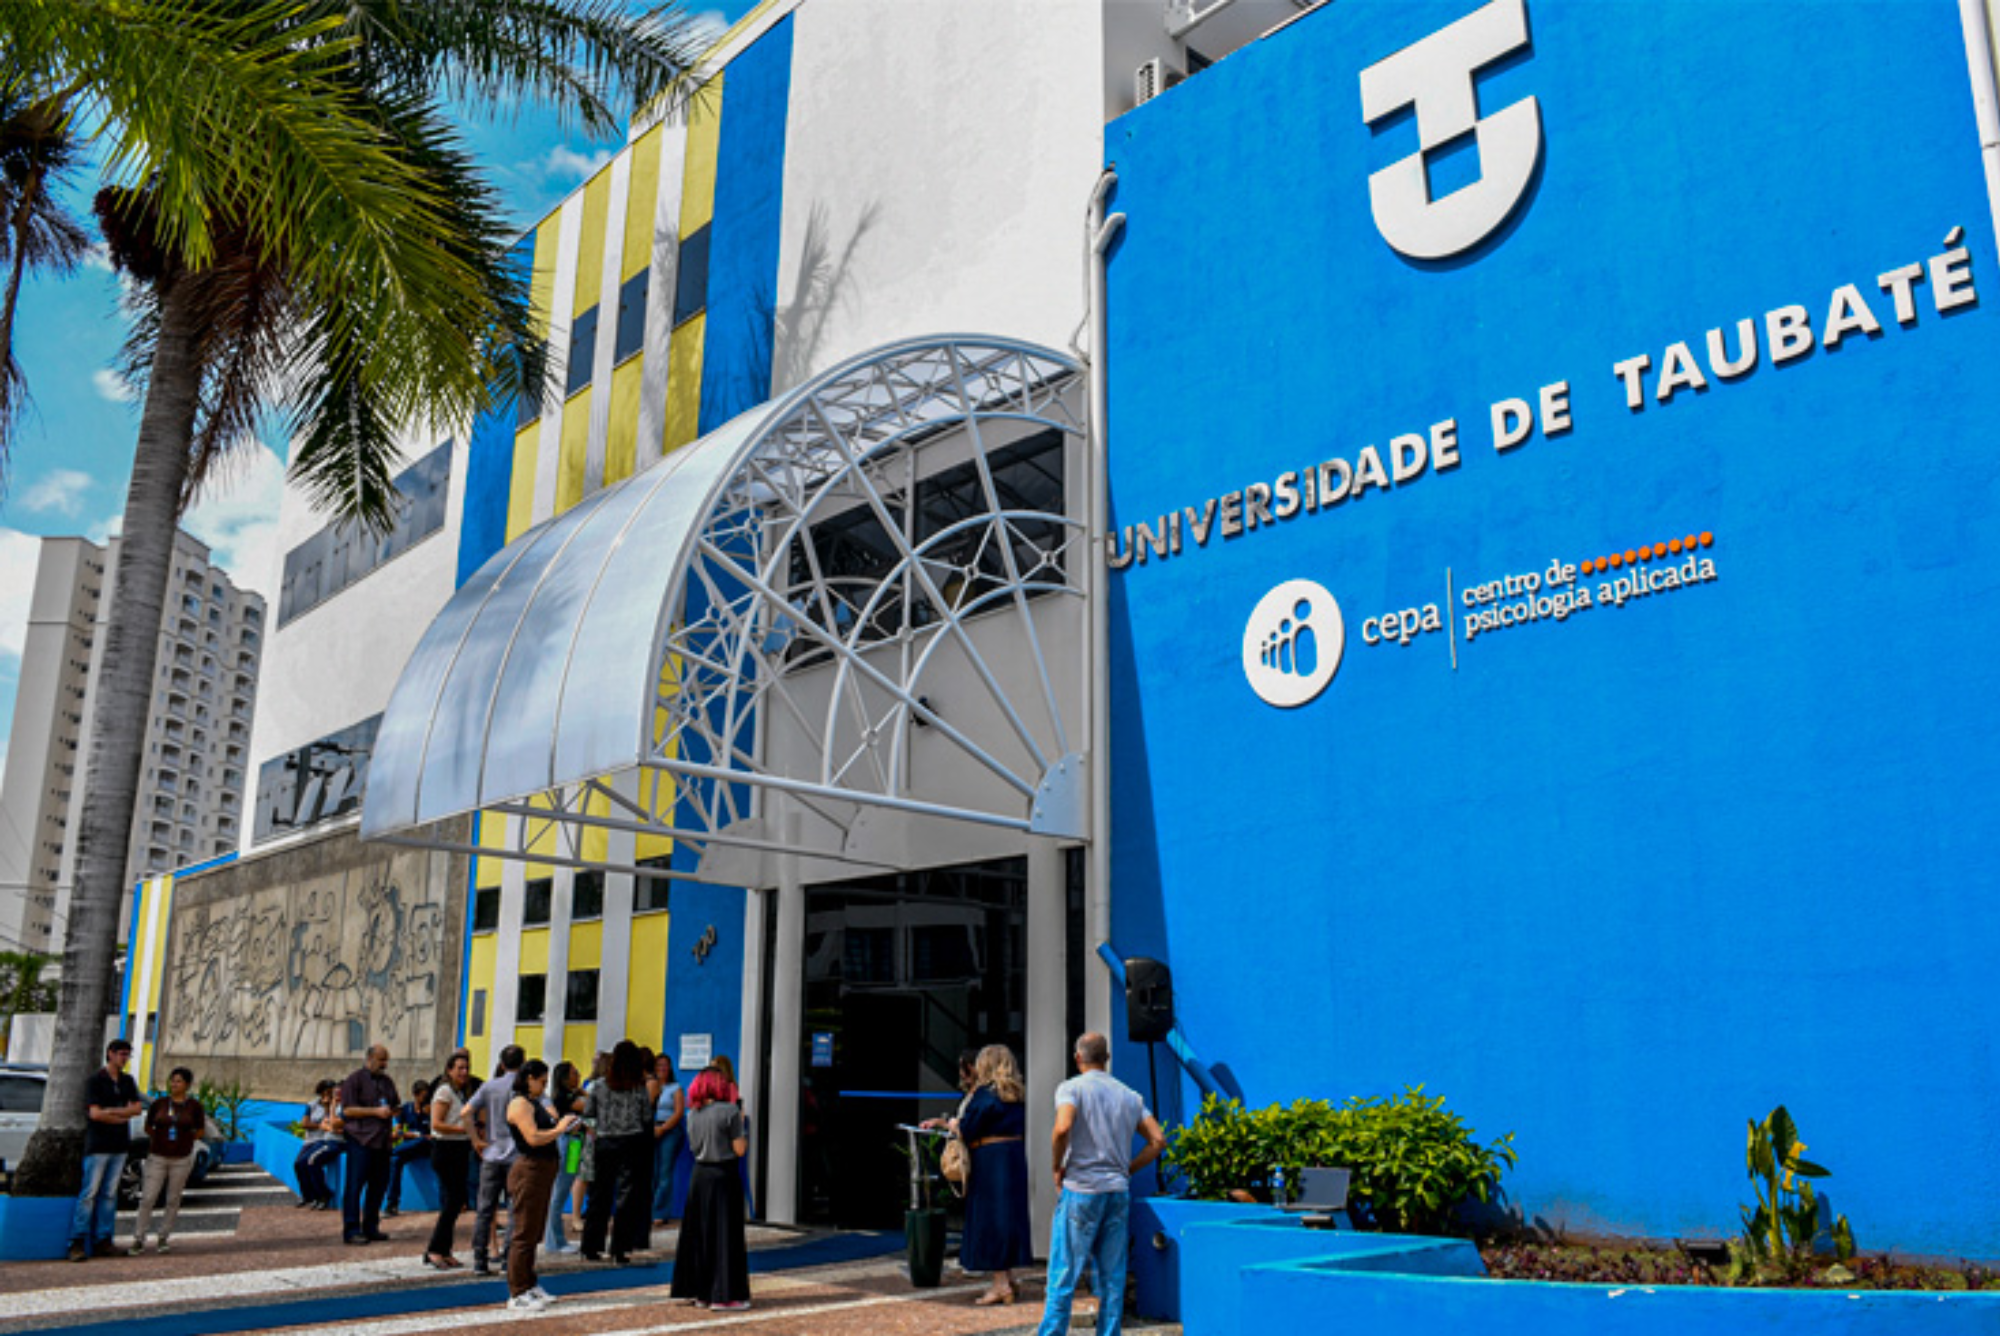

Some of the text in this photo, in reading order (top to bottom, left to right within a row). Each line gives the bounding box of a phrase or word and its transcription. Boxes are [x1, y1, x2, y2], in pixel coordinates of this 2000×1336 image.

[1106, 226, 1978, 570] UNIVERSIDADE DE TAUBATÉ
[1462, 558, 1577, 607] centro de
[1463, 556, 1717, 638] psicologia aplicada
[1362, 602, 1442, 643] cepa
